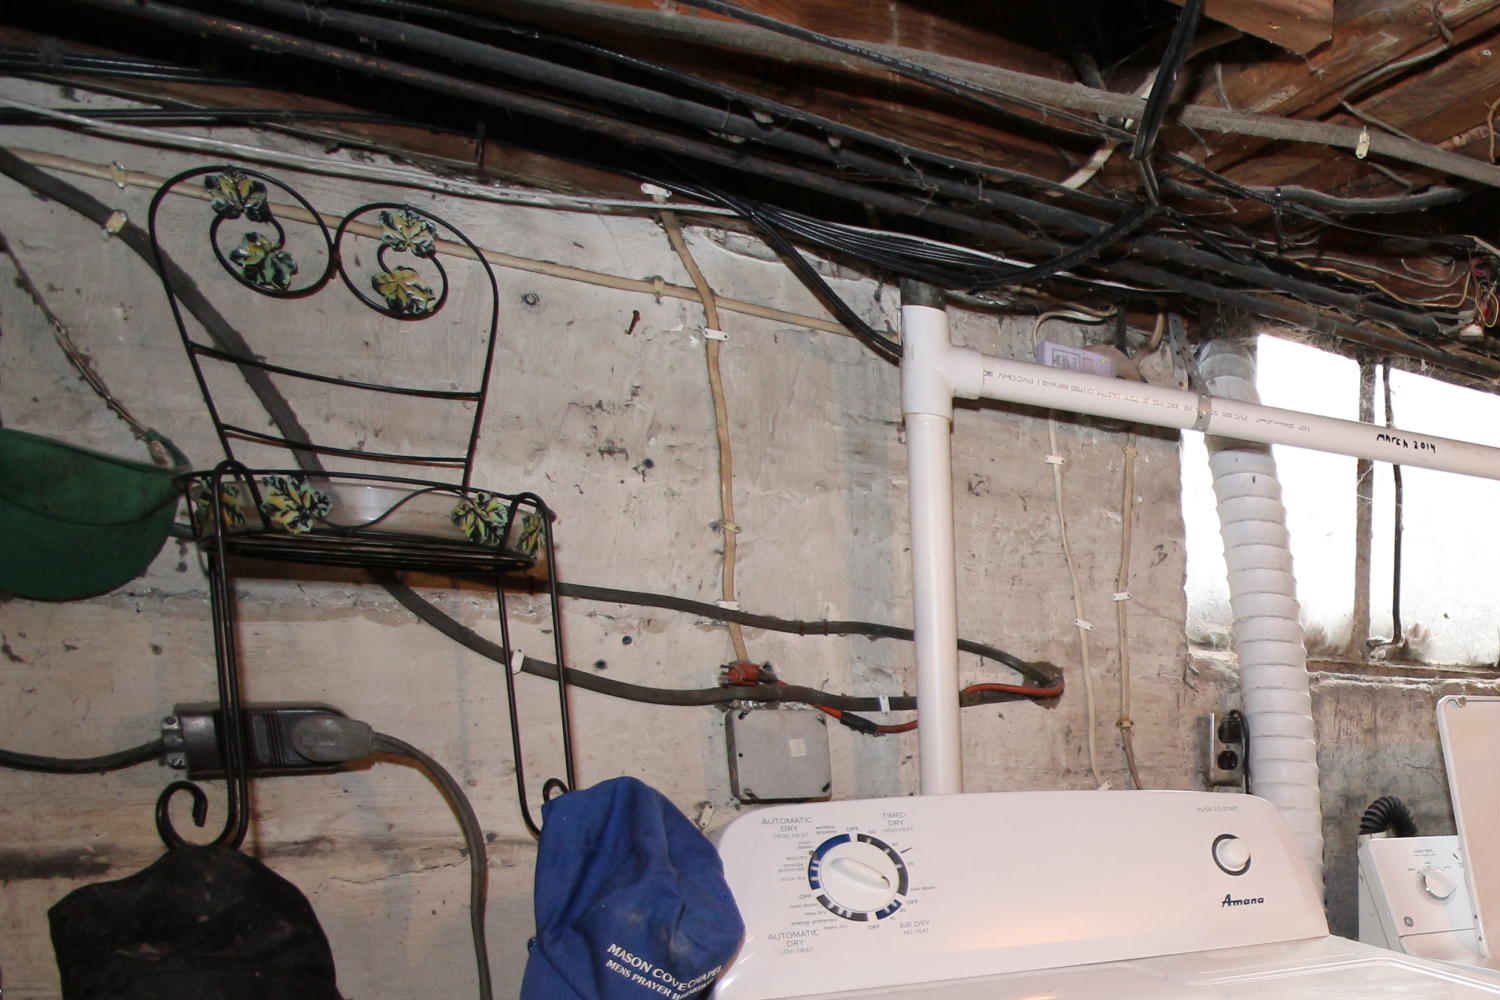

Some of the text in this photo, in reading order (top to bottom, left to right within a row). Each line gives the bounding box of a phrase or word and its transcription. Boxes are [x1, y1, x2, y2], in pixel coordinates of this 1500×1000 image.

[1413, 440, 1436, 454] 2014
[881, 811, 906, 820] TIMED
[761, 816, 813, 826] AUTOMATIC
[887, 819, 905, 827] DRY
[780, 825, 799, 833] DRY
[1222, 893, 1265, 908] Amana
[899, 919, 930, 929] AIR DRY
[768, 929, 820, 941] AUTOMATIC
[786, 939, 805, 948] DRY
[606, 943, 654, 974] MASON
[652, 968, 688, 992] COVE
[605, 959, 633, 978] MENS
[631, 973, 672, 998] PRAYER
